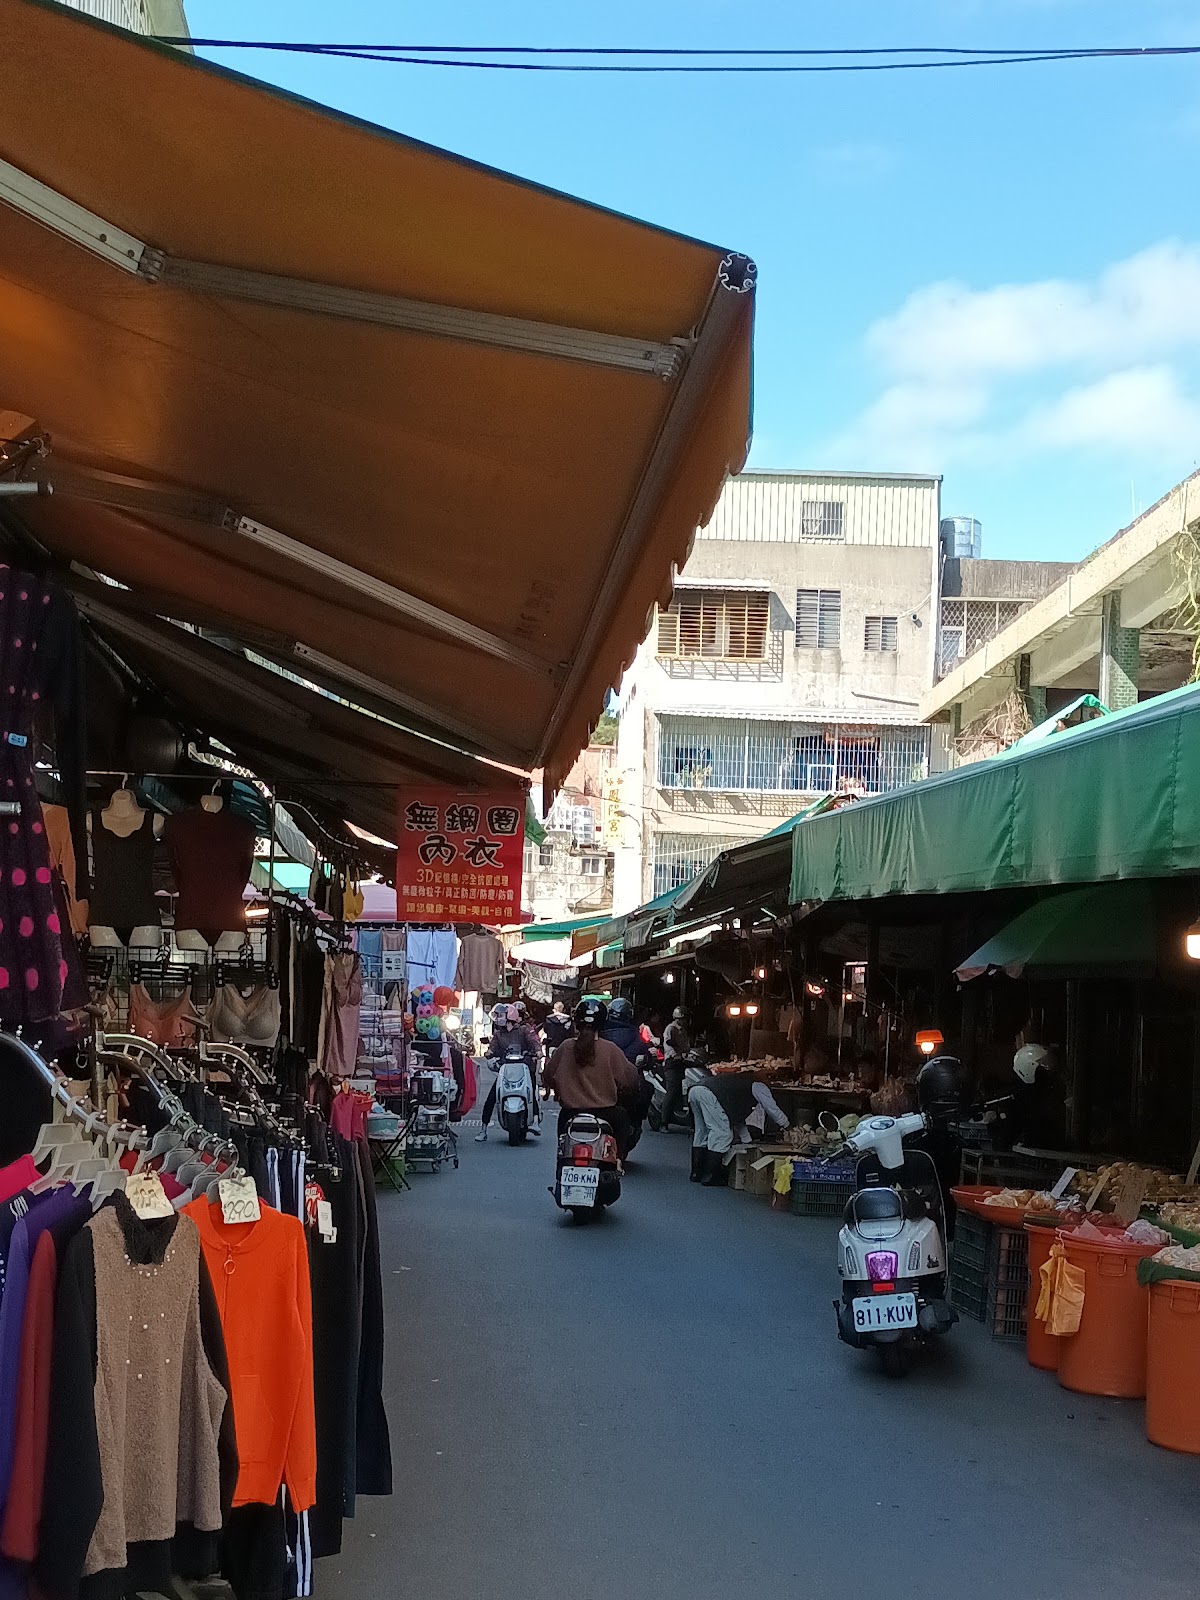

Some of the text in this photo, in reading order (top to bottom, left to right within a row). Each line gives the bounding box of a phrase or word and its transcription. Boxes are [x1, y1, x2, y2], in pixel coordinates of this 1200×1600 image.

[404, 800, 521, 836] 無鋼圈
[856, 1304, 914, 1326] 811-KUV
